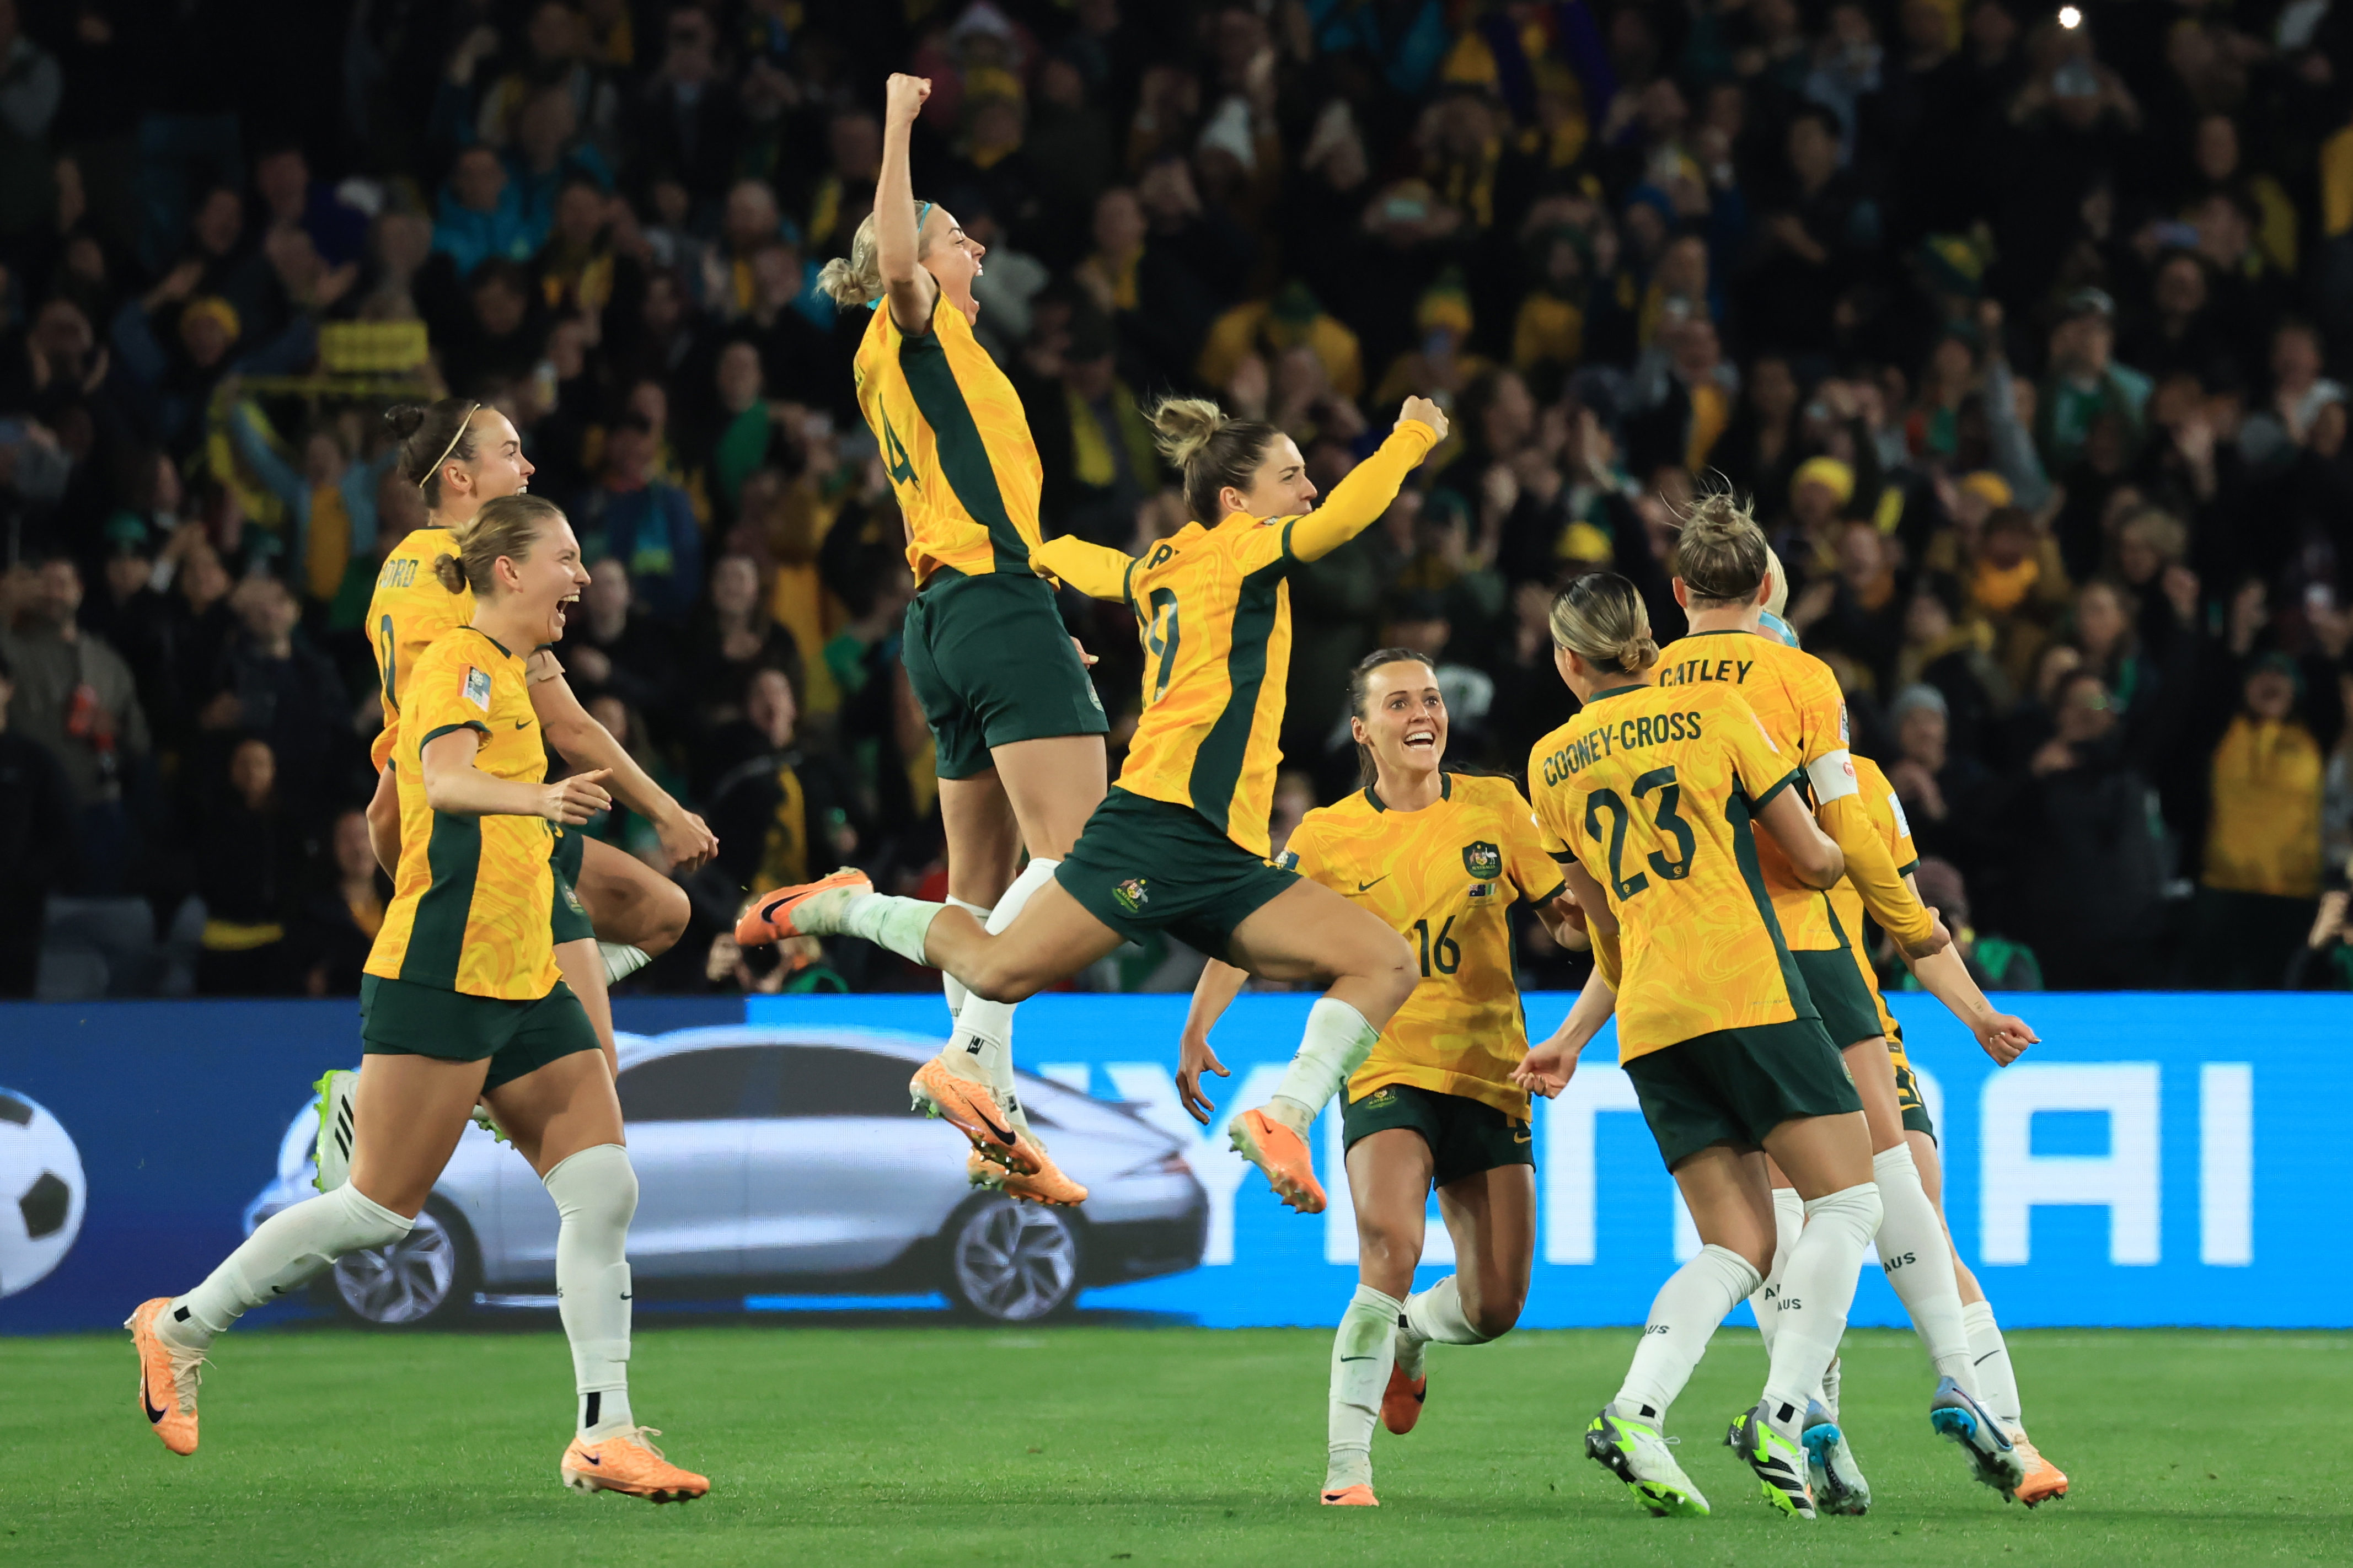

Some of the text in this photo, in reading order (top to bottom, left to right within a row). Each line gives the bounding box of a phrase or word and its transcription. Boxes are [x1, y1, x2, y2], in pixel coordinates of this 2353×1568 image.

[1659, 659, 1754, 688] CATLEY
[1543, 711, 1702, 787] COONEY-CROSS
[1585, 765, 1696, 901] 23
[1413, 915, 1461, 978] 16
[1884, 1252, 1916, 1275] AUS
[1777, 1298, 1802, 1312] AUS
